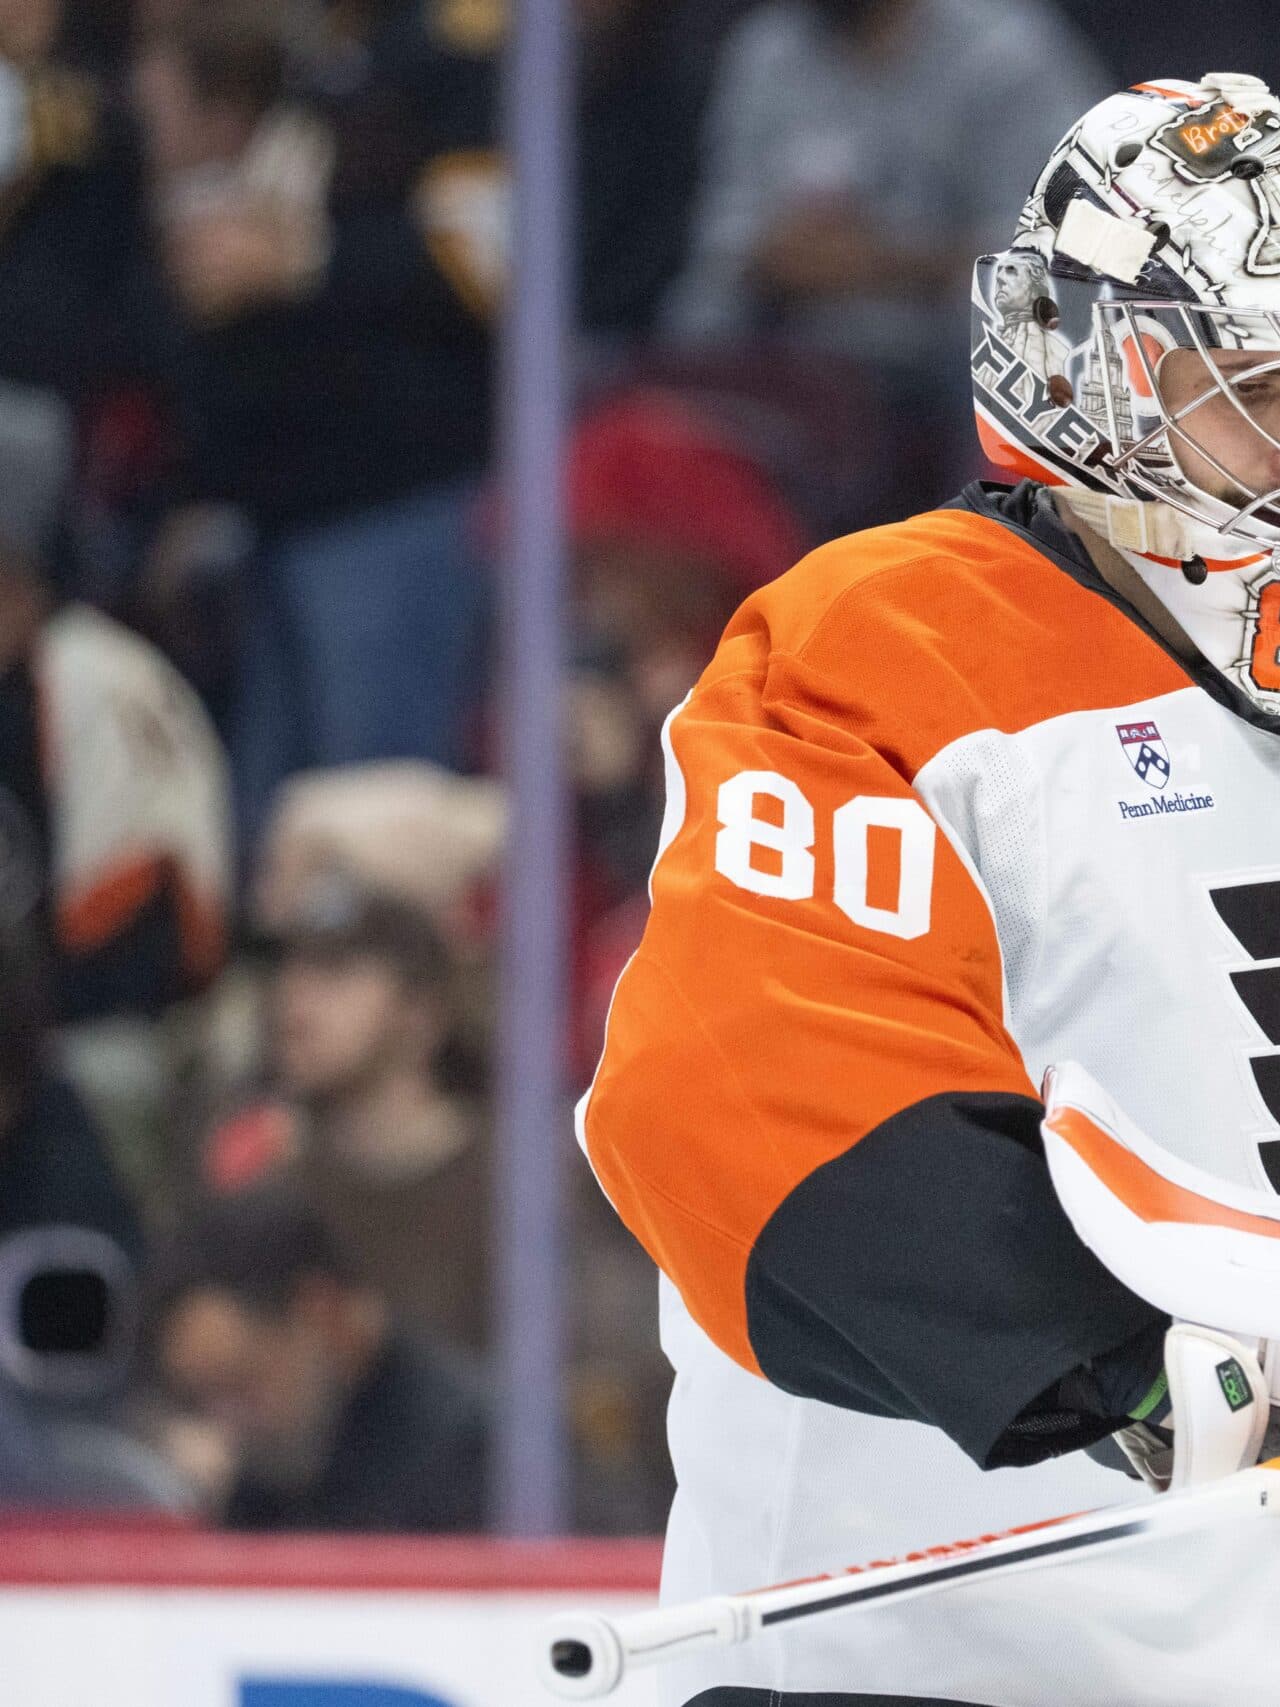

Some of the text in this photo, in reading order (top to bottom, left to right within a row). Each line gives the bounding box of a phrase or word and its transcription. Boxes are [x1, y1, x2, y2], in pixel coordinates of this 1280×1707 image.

[1118, 792, 1215, 819] Penn Medicine
[715, 770, 937, 941] 80
